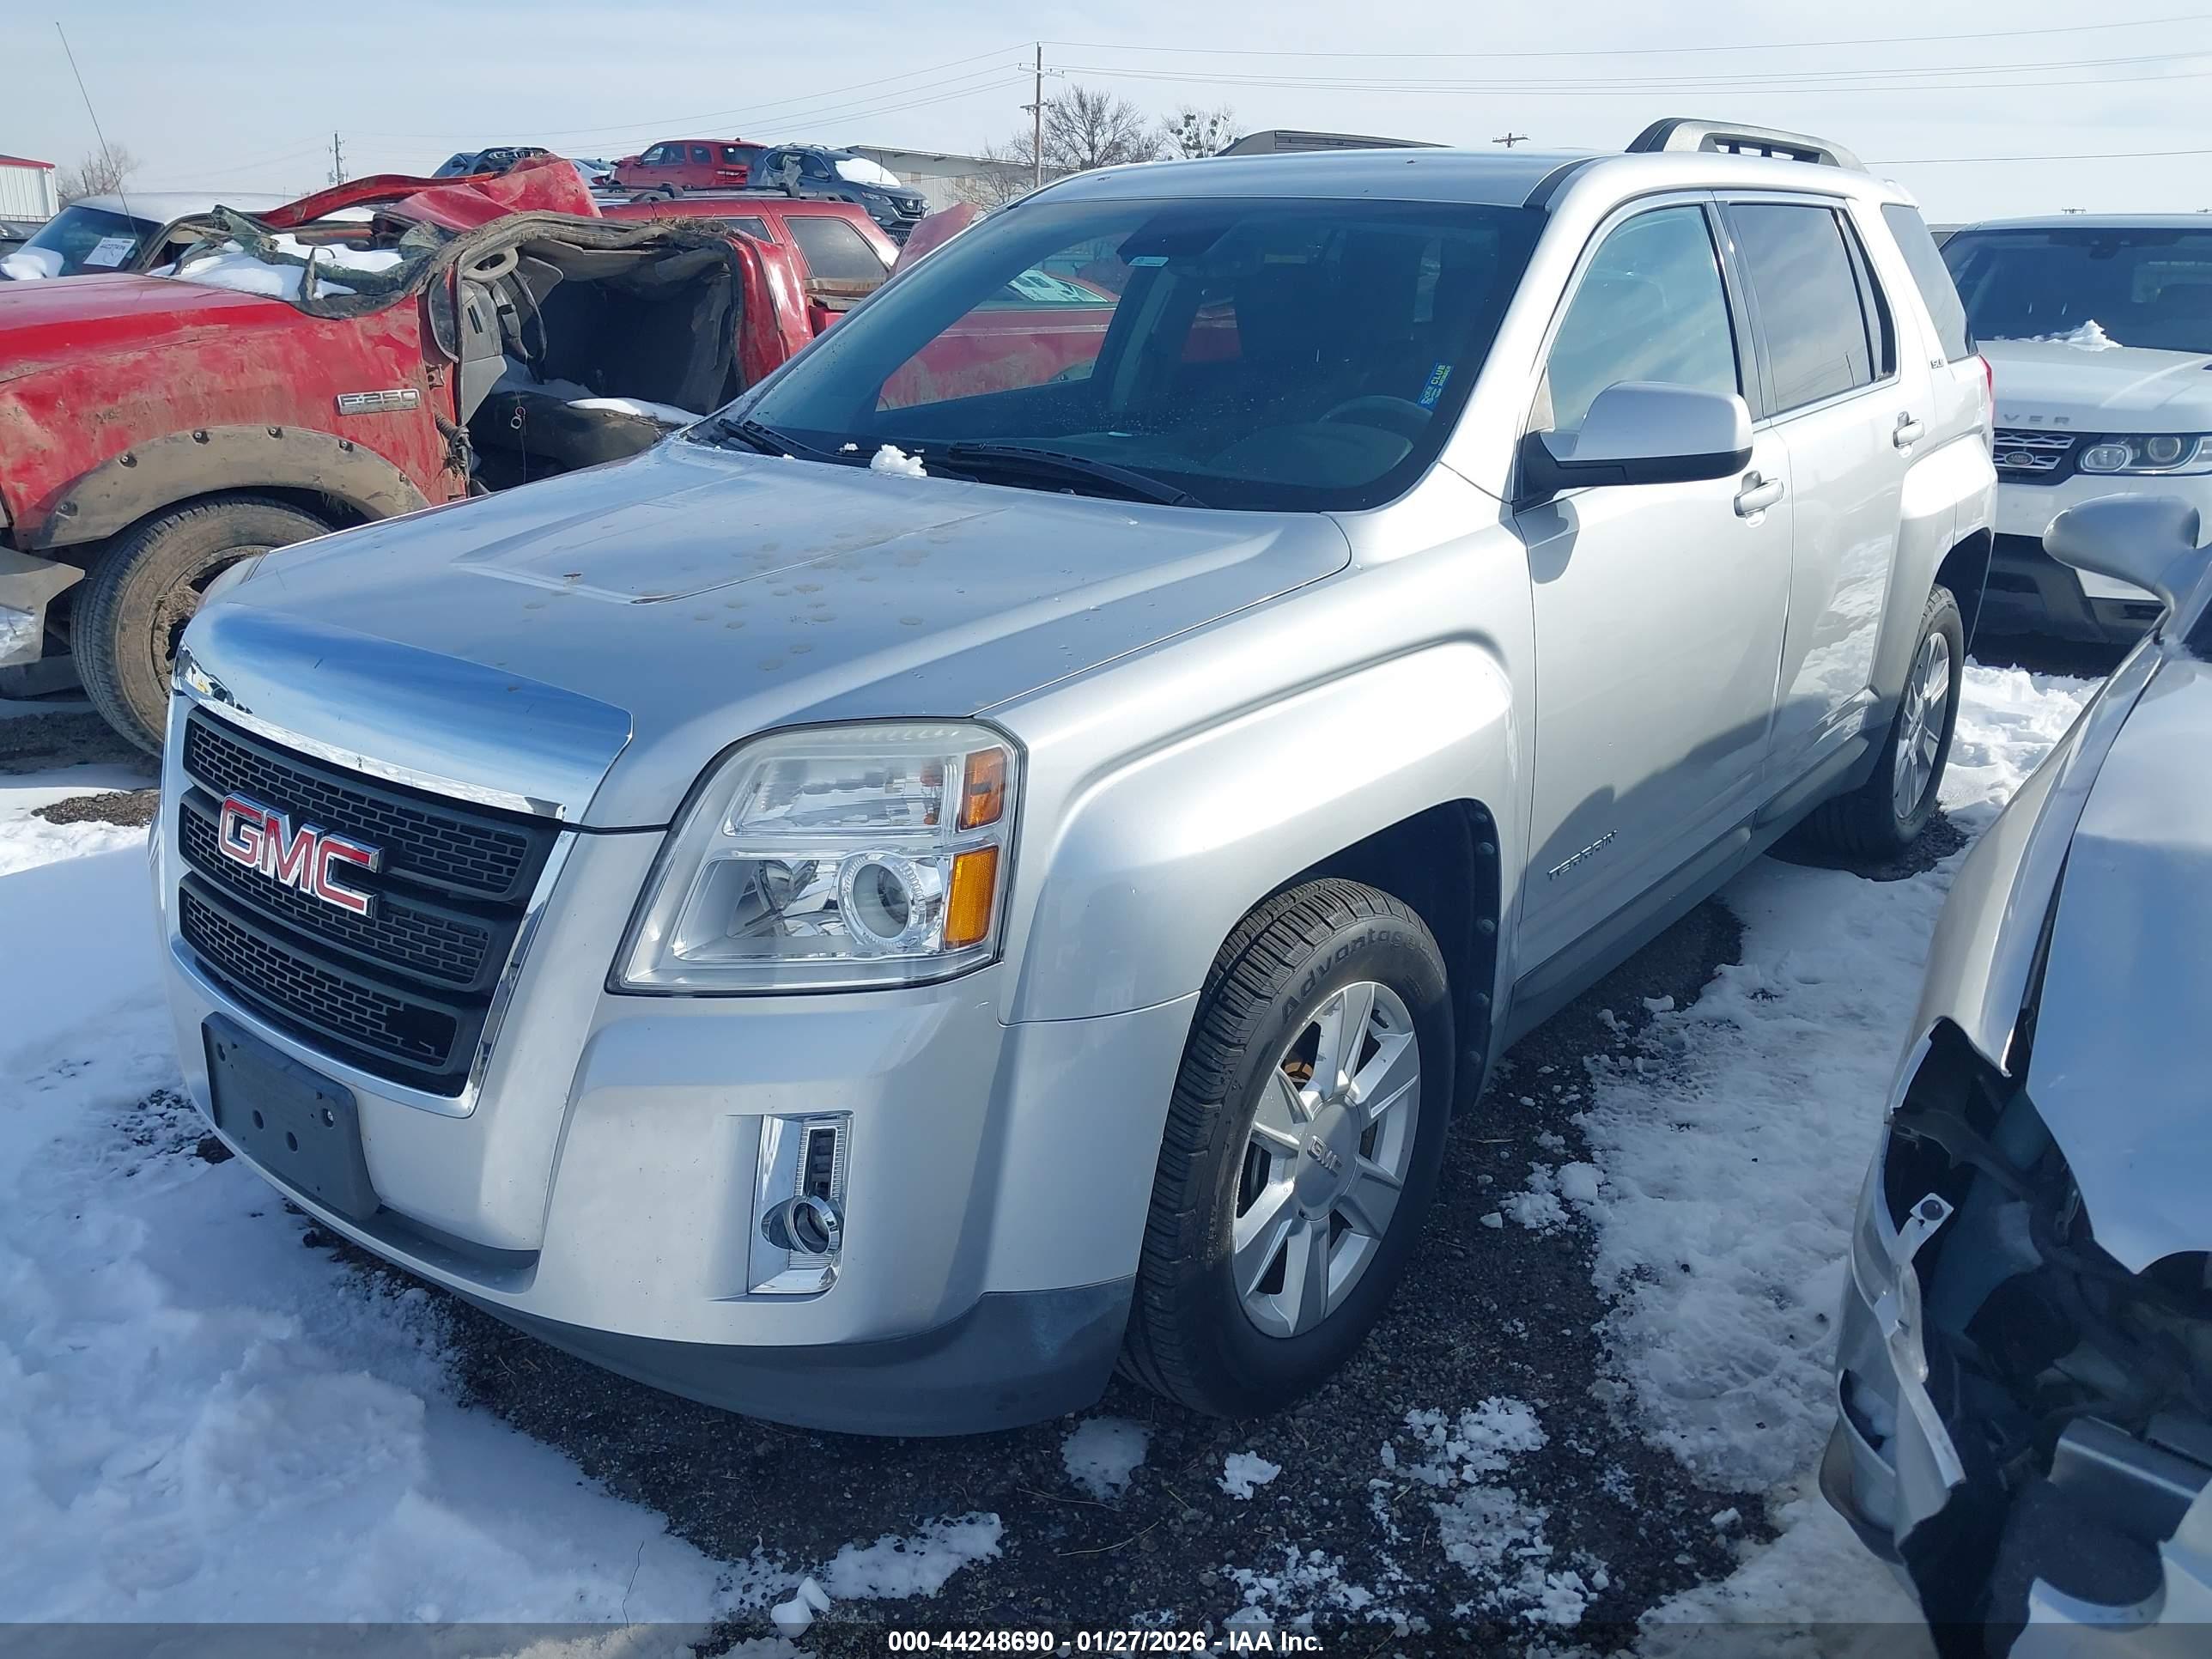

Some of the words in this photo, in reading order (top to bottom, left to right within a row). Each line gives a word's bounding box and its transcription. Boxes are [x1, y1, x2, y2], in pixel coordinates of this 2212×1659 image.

[1431, 365, 1446, 385] CLUB
[2003, 414, 2070, 425] VER
[218, 791, 381, 919] GMC
[1307, 1134, 1343, 1178] GMC
